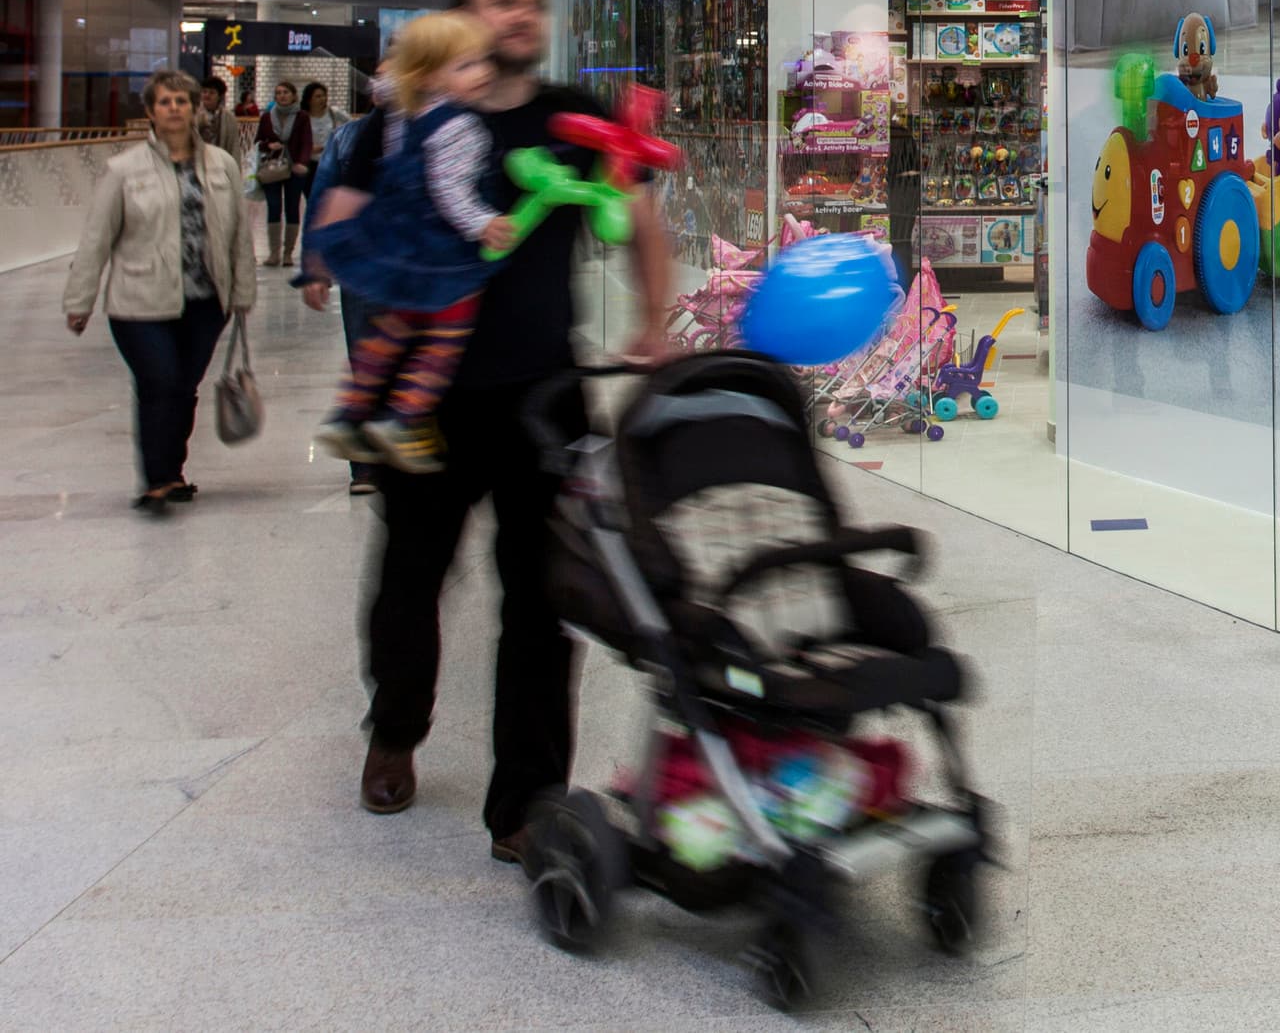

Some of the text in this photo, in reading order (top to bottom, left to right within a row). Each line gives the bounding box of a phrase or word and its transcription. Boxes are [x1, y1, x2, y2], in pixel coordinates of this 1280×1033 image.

[1212, 136, 1219, 154] 4
[1231, 137, 1238, 155] 5
[1196, 149, 1203, 167] 3
[1184, 186, 1191, 204] 2
[1180, 226, 1186, 245] 1
